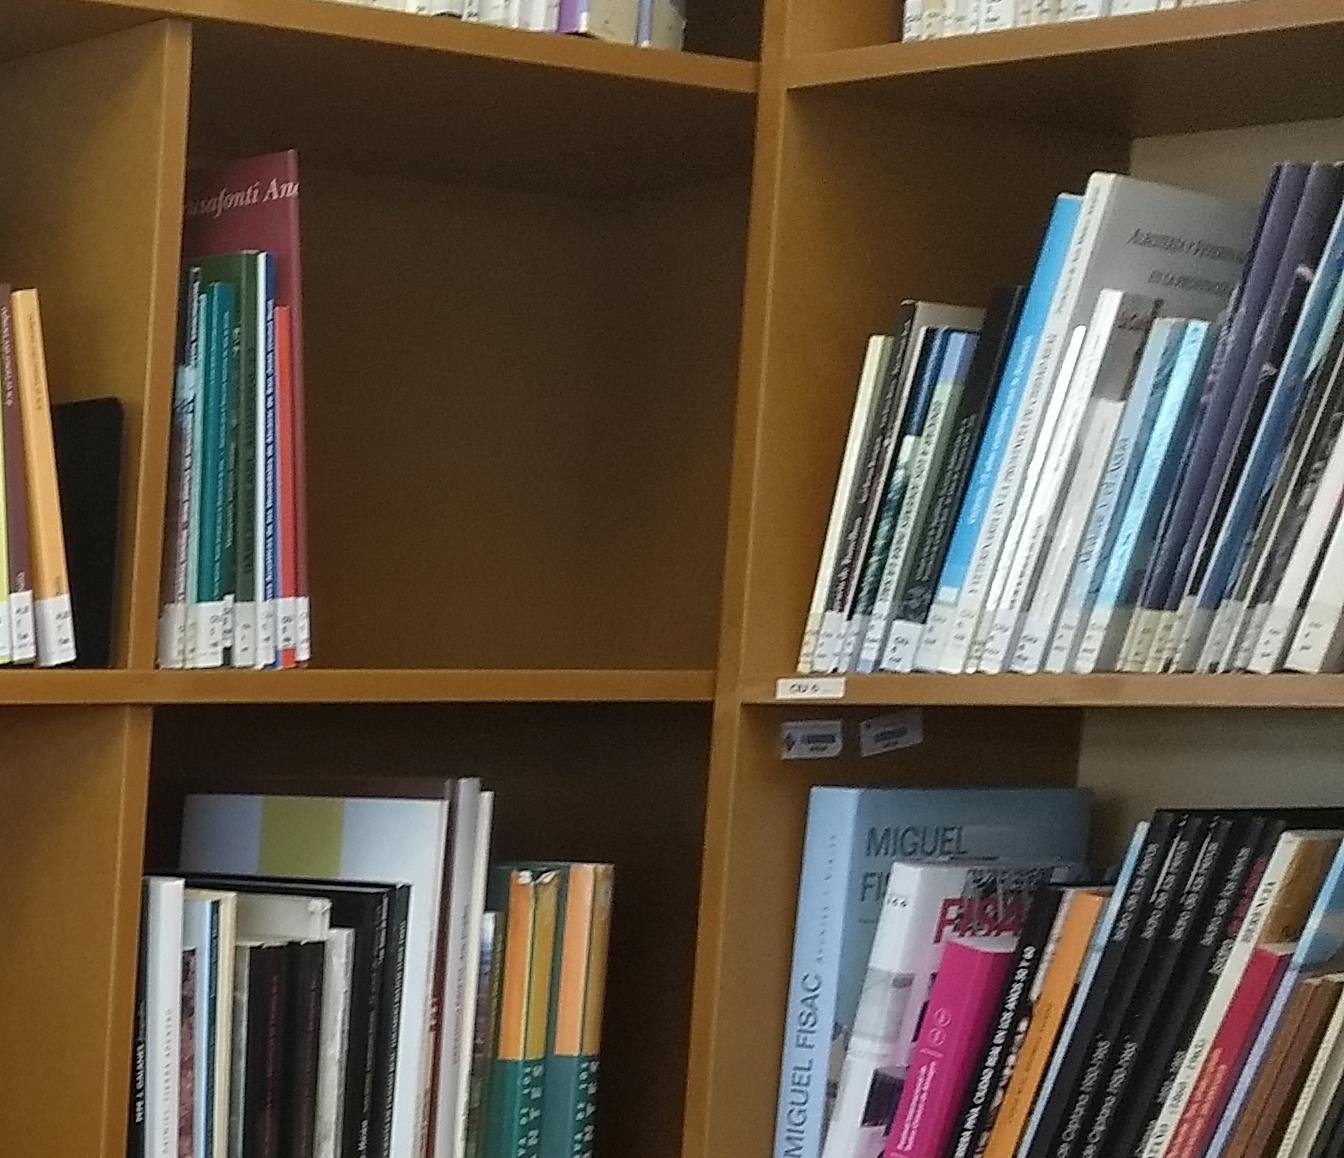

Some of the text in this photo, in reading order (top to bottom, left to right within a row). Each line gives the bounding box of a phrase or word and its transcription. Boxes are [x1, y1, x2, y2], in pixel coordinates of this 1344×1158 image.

[865, 821, 968, 860] MIGUEL
[784, 972, 821, 1158] MIGUEL FISAC
